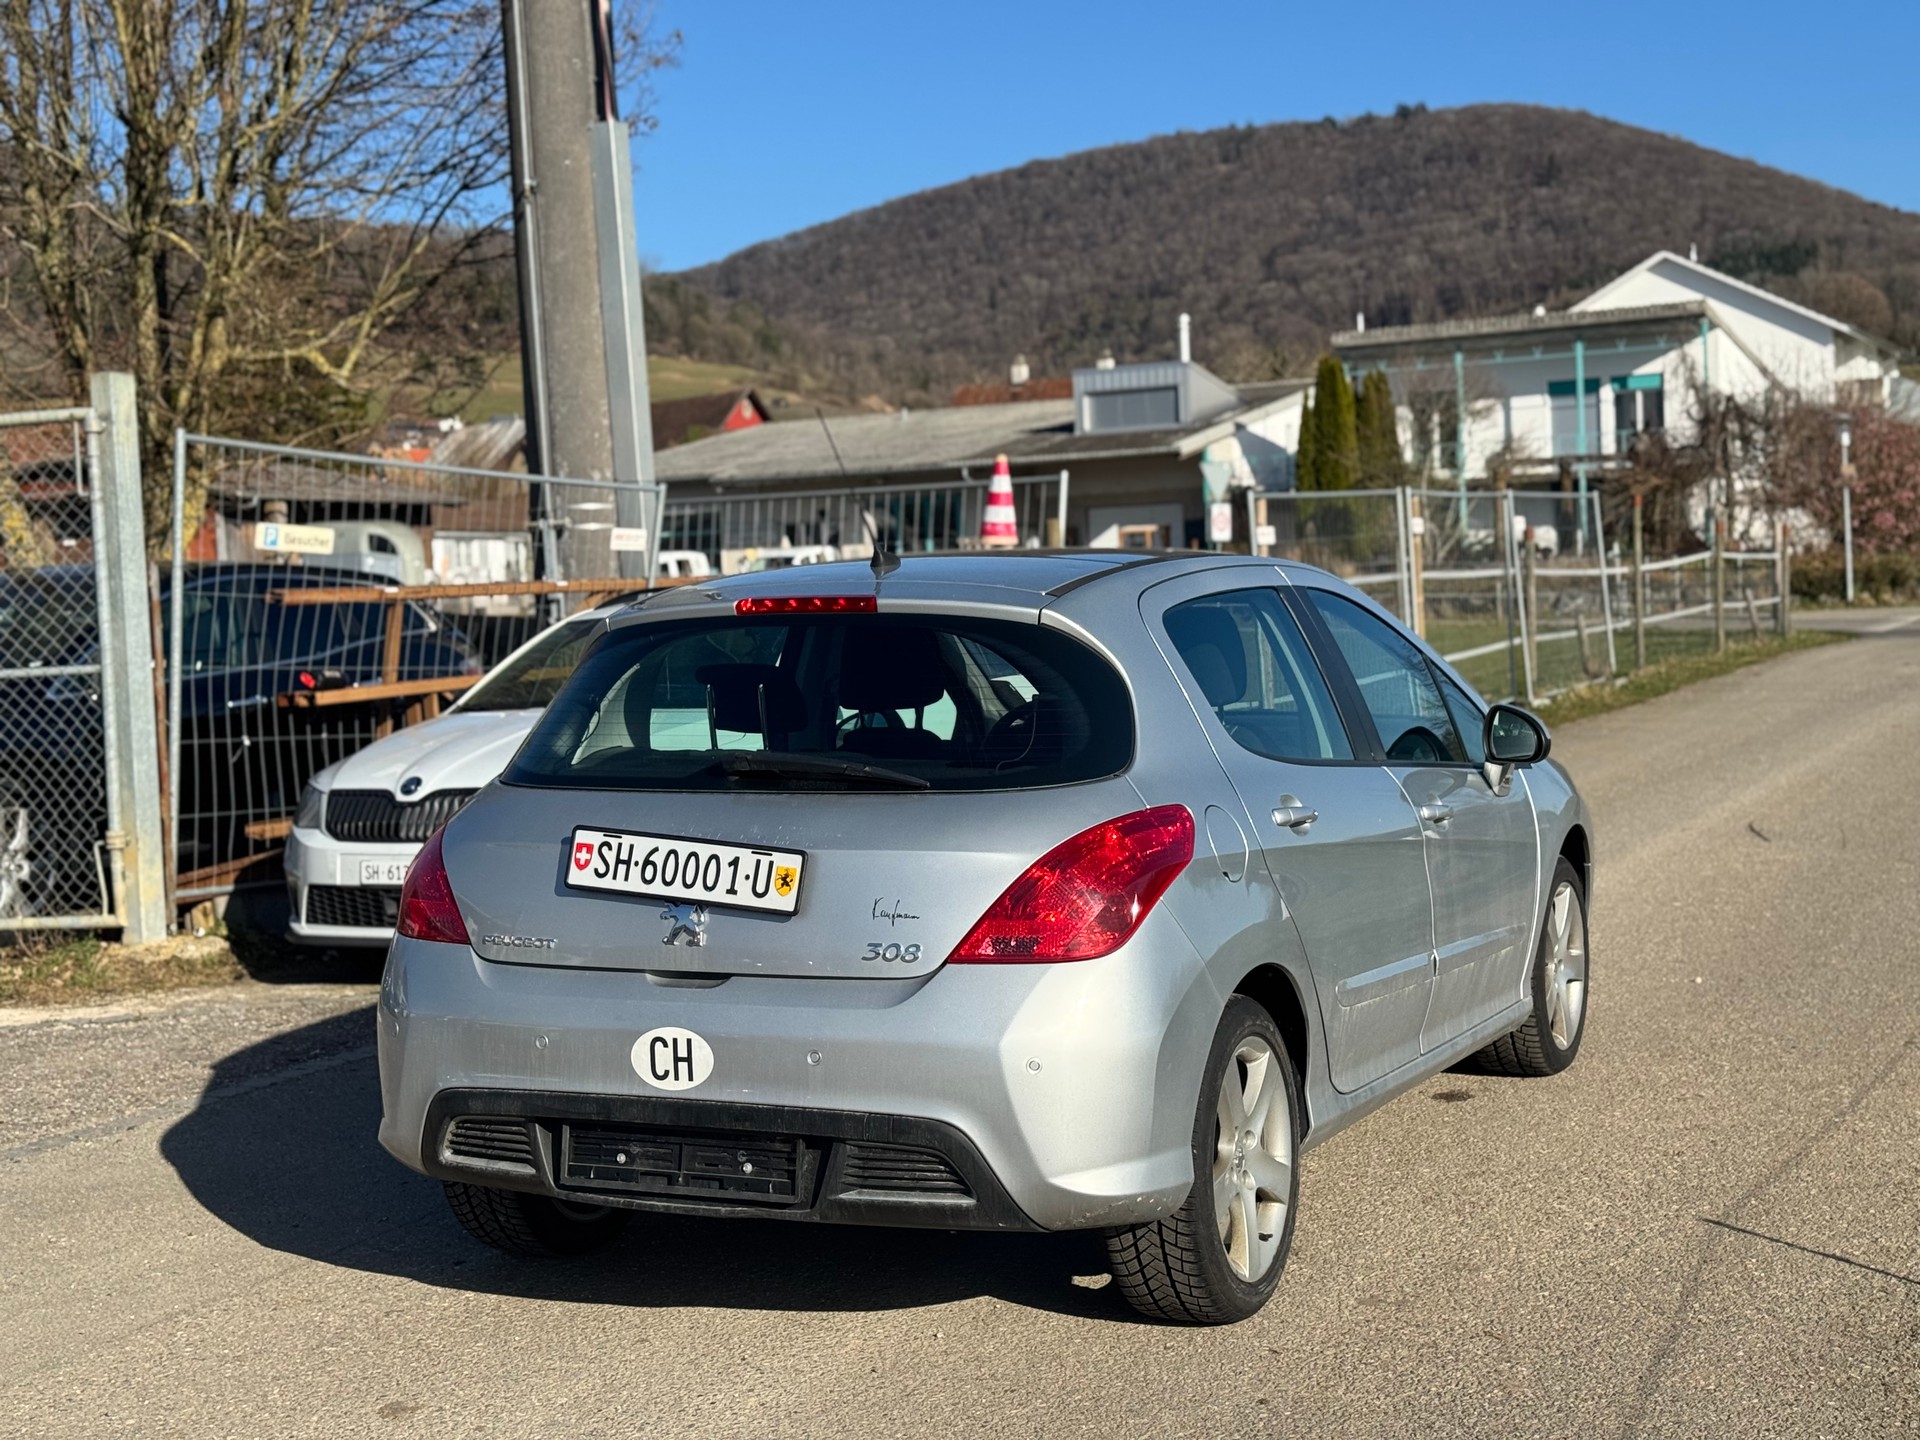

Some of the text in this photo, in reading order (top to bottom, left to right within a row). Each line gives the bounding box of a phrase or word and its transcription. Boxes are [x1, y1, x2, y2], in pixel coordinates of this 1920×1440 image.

[482, 933, 558, 949] PEUGEOT
[861, 942, 922, 964] 308
[650, 1036, 694, 1082] CH
